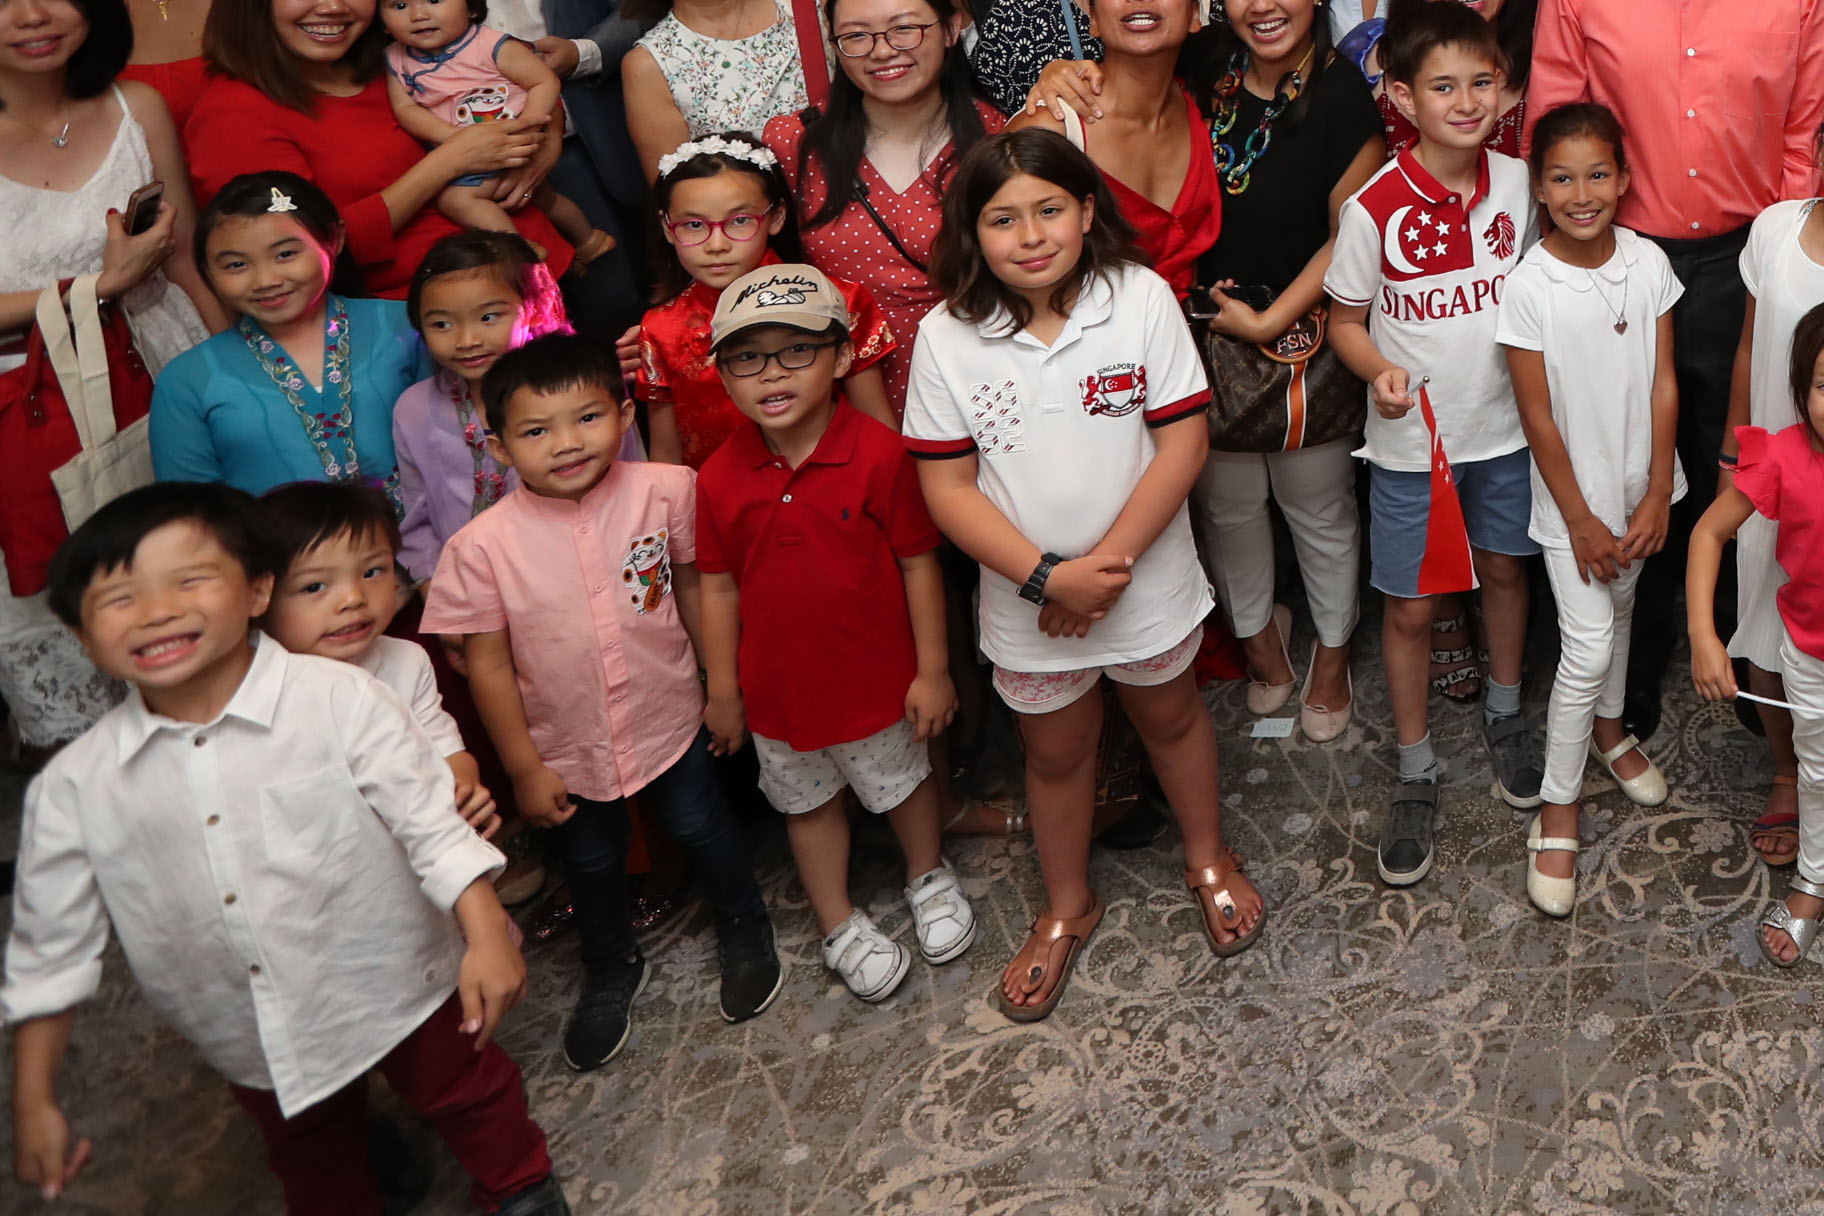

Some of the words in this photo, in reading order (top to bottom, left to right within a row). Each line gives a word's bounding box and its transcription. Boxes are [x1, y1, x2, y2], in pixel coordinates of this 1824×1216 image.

[729, 275, 818, 313] Michelin
[1277, 333, 1312, 354] FSN
[1097, 363, 1136, 375] SINGAPORE
